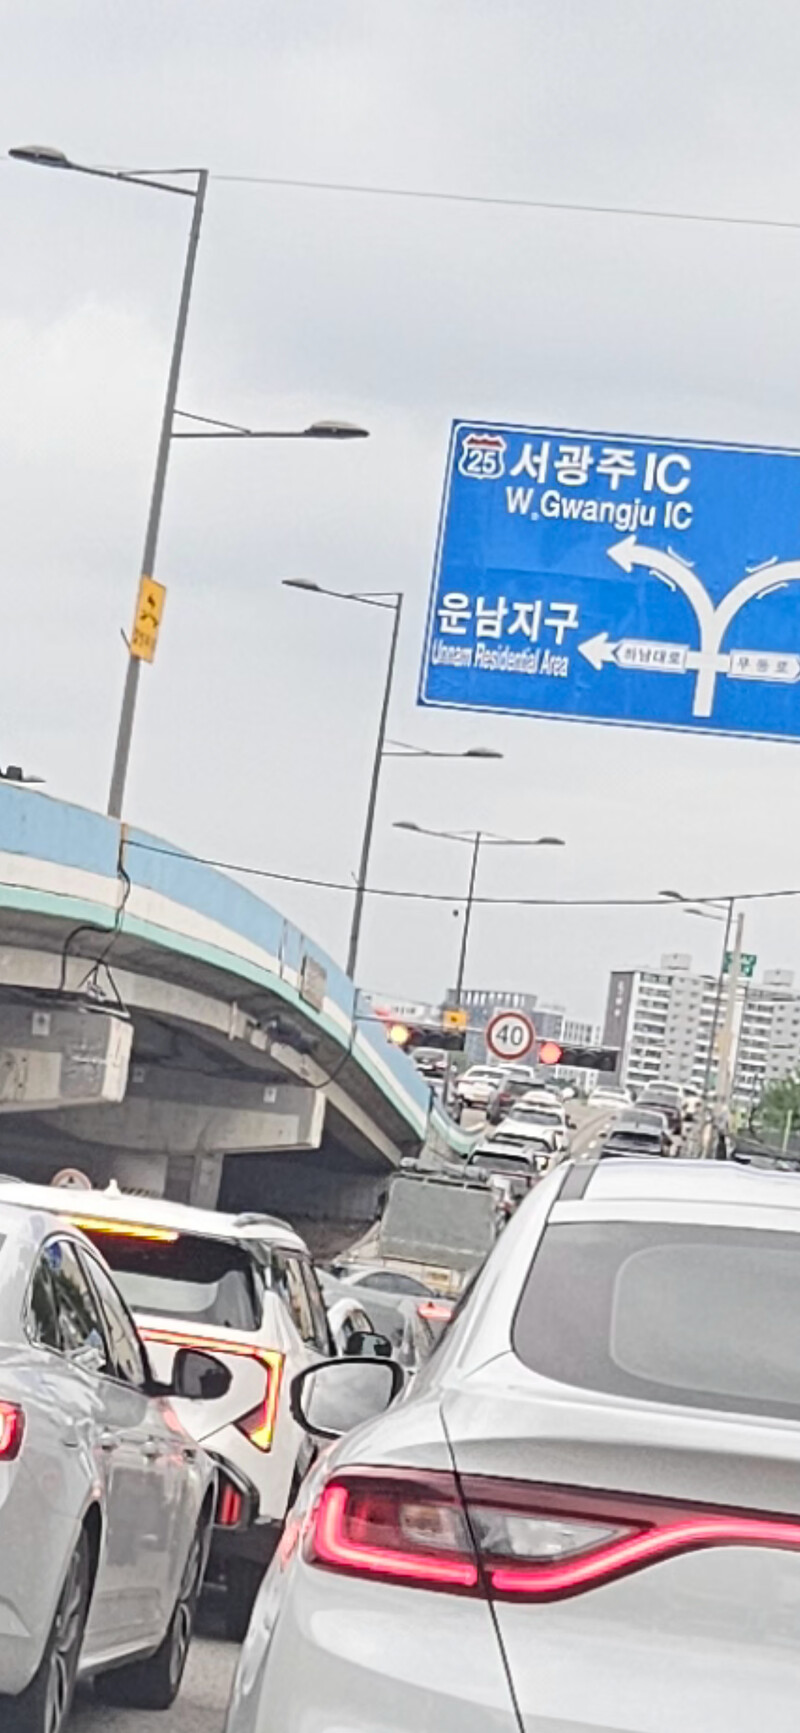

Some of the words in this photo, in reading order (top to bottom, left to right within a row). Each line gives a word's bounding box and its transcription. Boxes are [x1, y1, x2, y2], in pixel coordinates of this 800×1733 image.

[467, 449, 497, 474] 25
[663, 500, 694, 531] IC
[437, 592, 580, 645] 운남지구
[431, 638, 473, 667] Unnam
[473, 642, 541, 675] Residential
[539, 648, 569, 678] Area
[495, 1024, 524, 1045] 40
